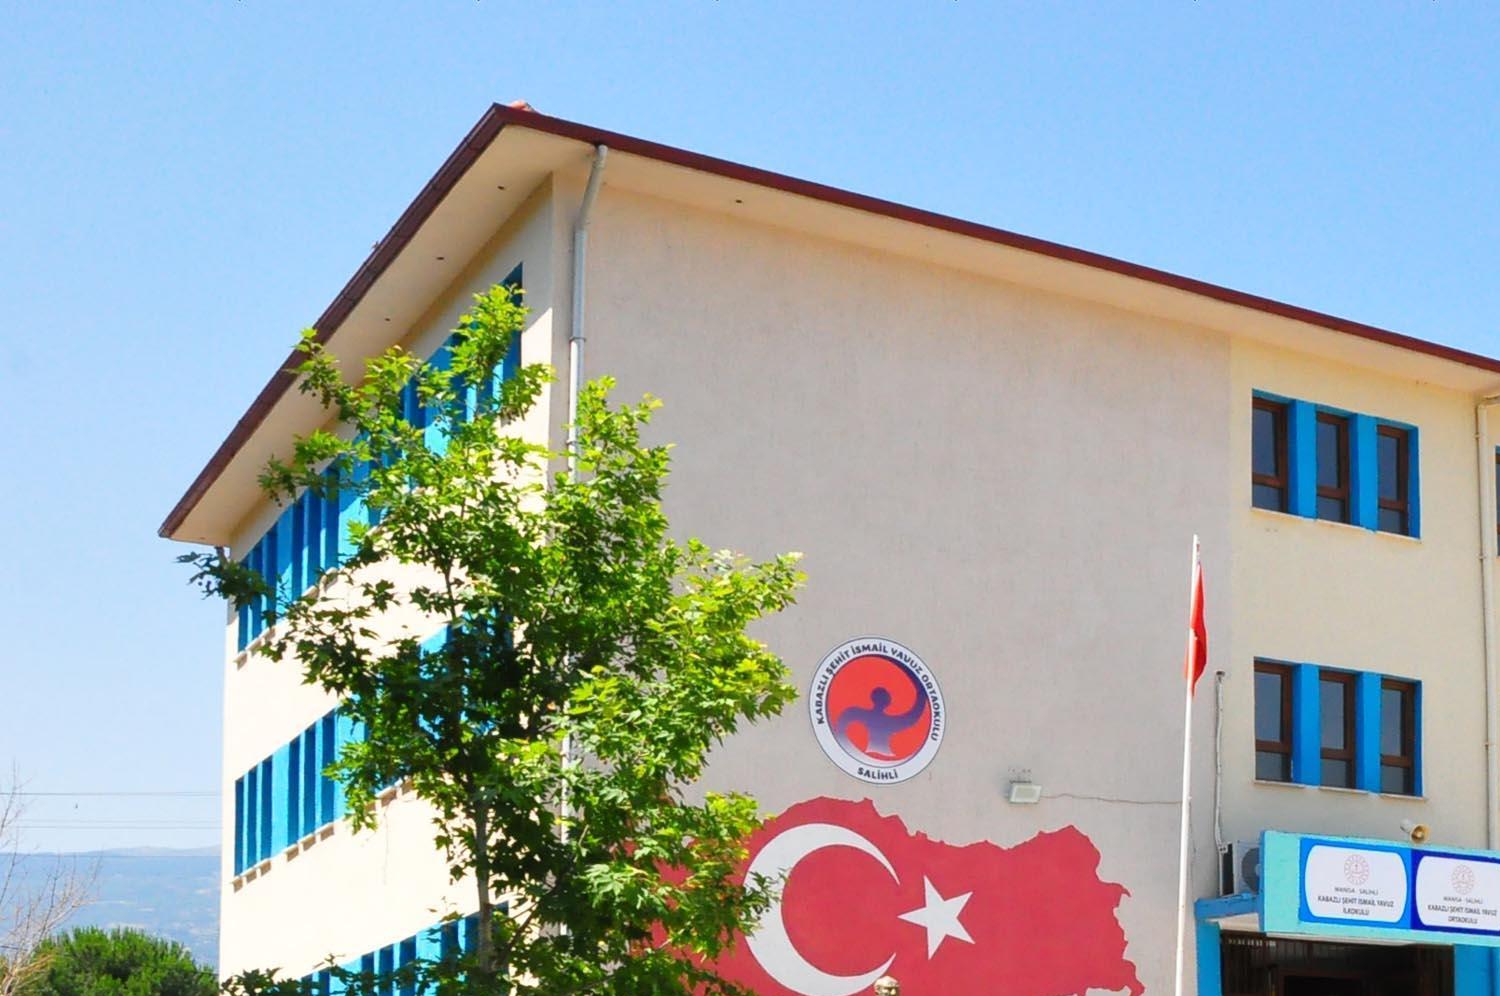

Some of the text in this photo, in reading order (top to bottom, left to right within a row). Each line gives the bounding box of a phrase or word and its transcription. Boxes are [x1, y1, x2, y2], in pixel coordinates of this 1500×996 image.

[815, 642, 942, 741] KABAZLI ŞEHİT İSMAİL YAVUZ ORTAOKULU
[857, 767, 899, 781] SALİHLİ
